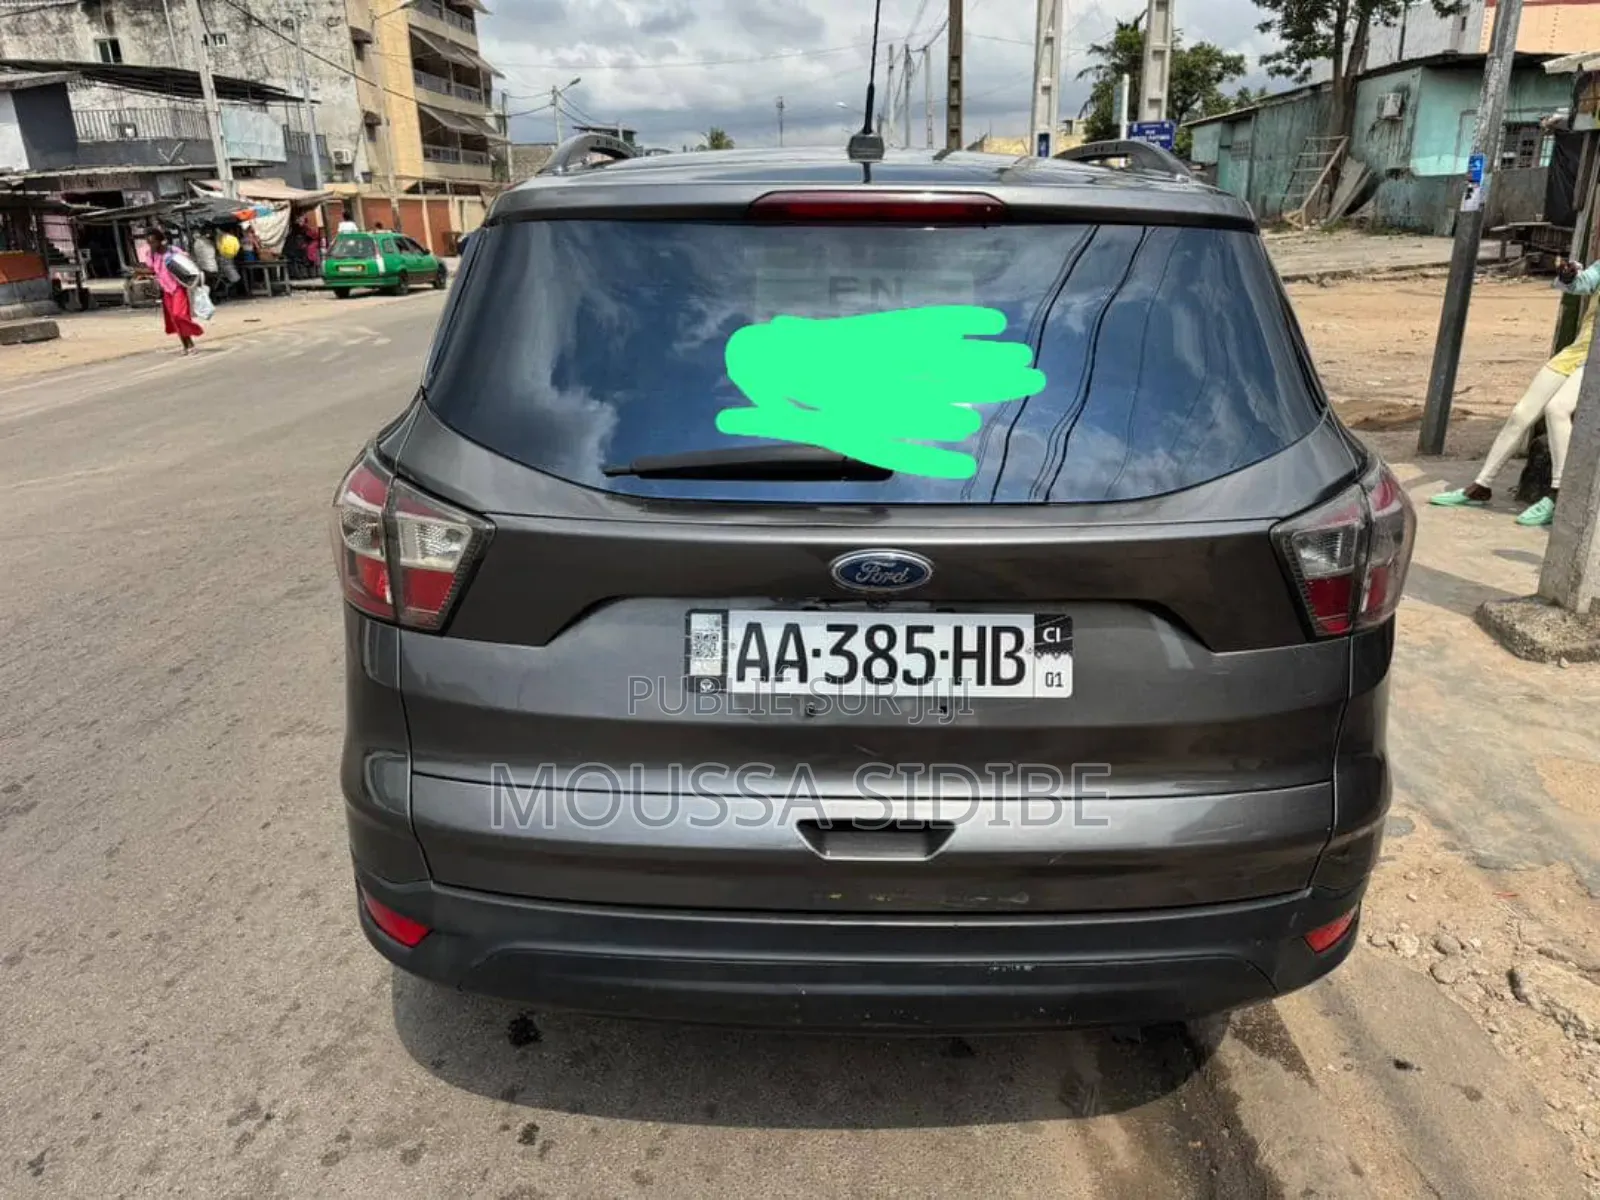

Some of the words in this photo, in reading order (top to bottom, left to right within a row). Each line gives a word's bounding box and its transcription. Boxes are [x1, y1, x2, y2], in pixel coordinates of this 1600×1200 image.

[855, 560, 911, 584] Ford
[1042, 626, 1061, 643] CI
[1045, 671, 1064, 688] 01
